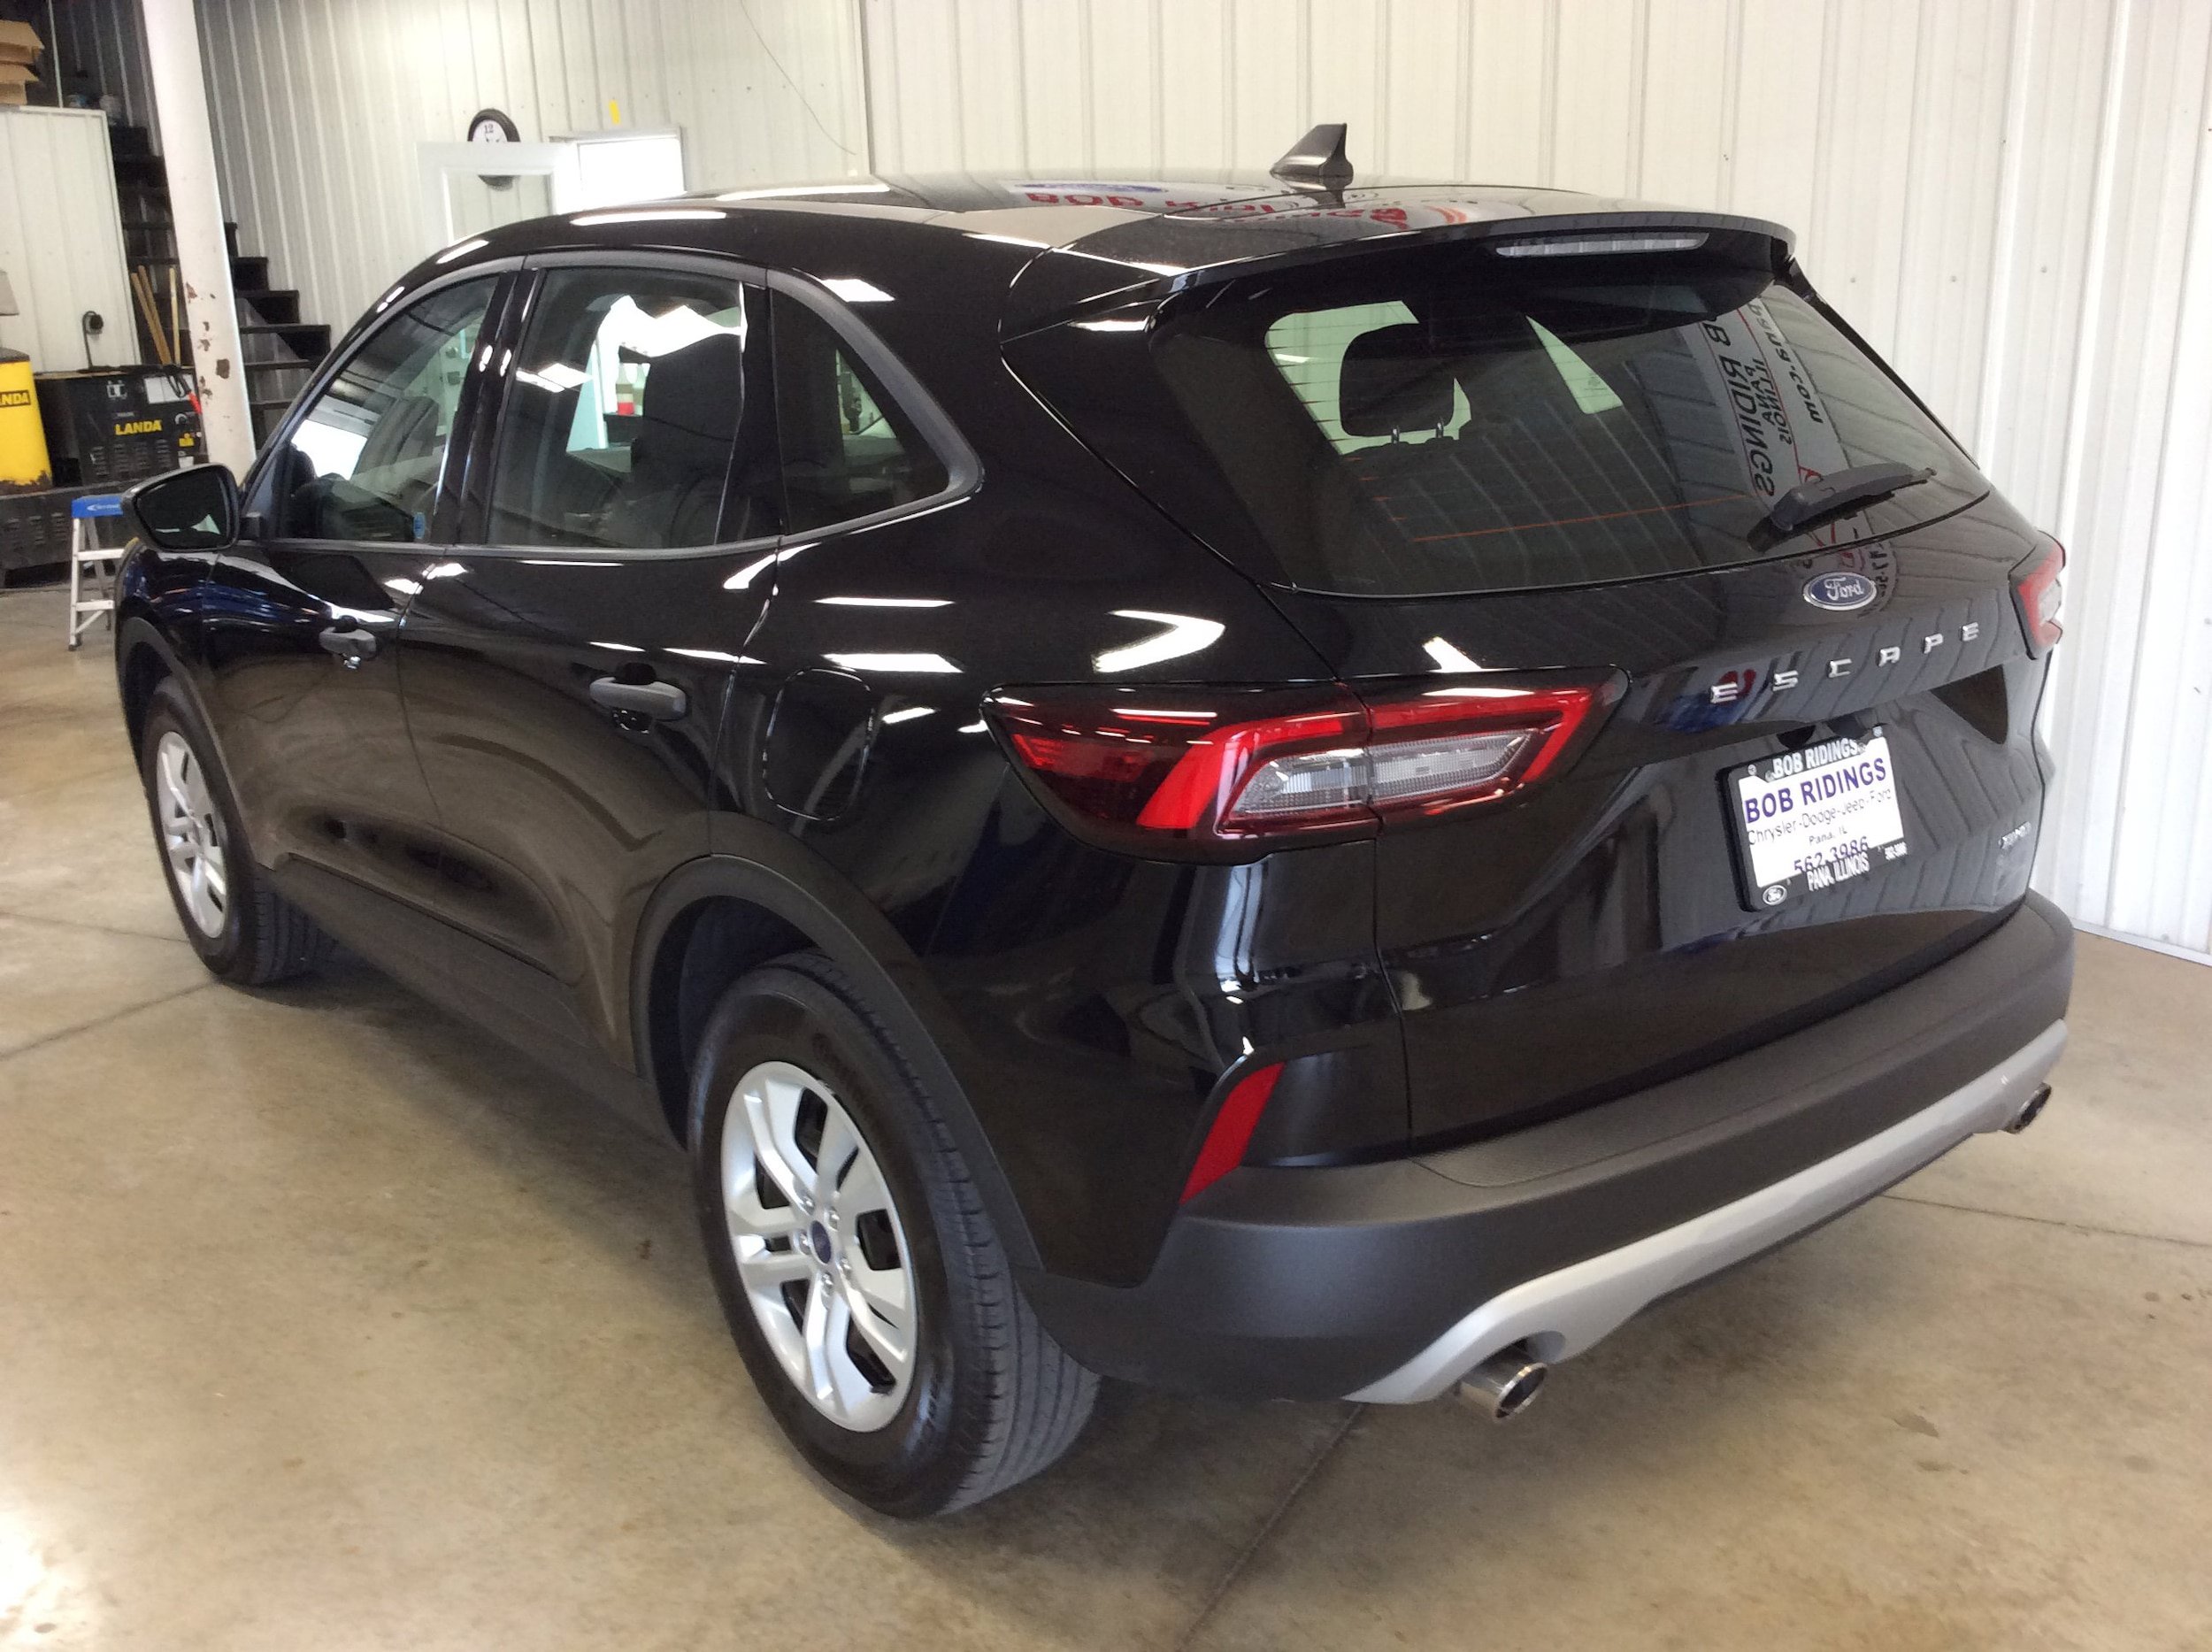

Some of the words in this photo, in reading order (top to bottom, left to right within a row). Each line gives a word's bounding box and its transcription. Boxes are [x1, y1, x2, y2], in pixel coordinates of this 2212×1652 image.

[484, 123, 494, 134] 12
[0, 391, 28, 406] NDA
[114, 419, 162, 436] LANDA
[1824, 577, 1865, 601] Ford
[1711, 622, 1979, 704] ESCAPE
[1771, 753, 1805, 780] BOB
[1805, 737, 1859, 769] RIDINGS
[1745, 788, 1793, 824] BOB
[1800, 757, 1886, 806] RIDINGS
